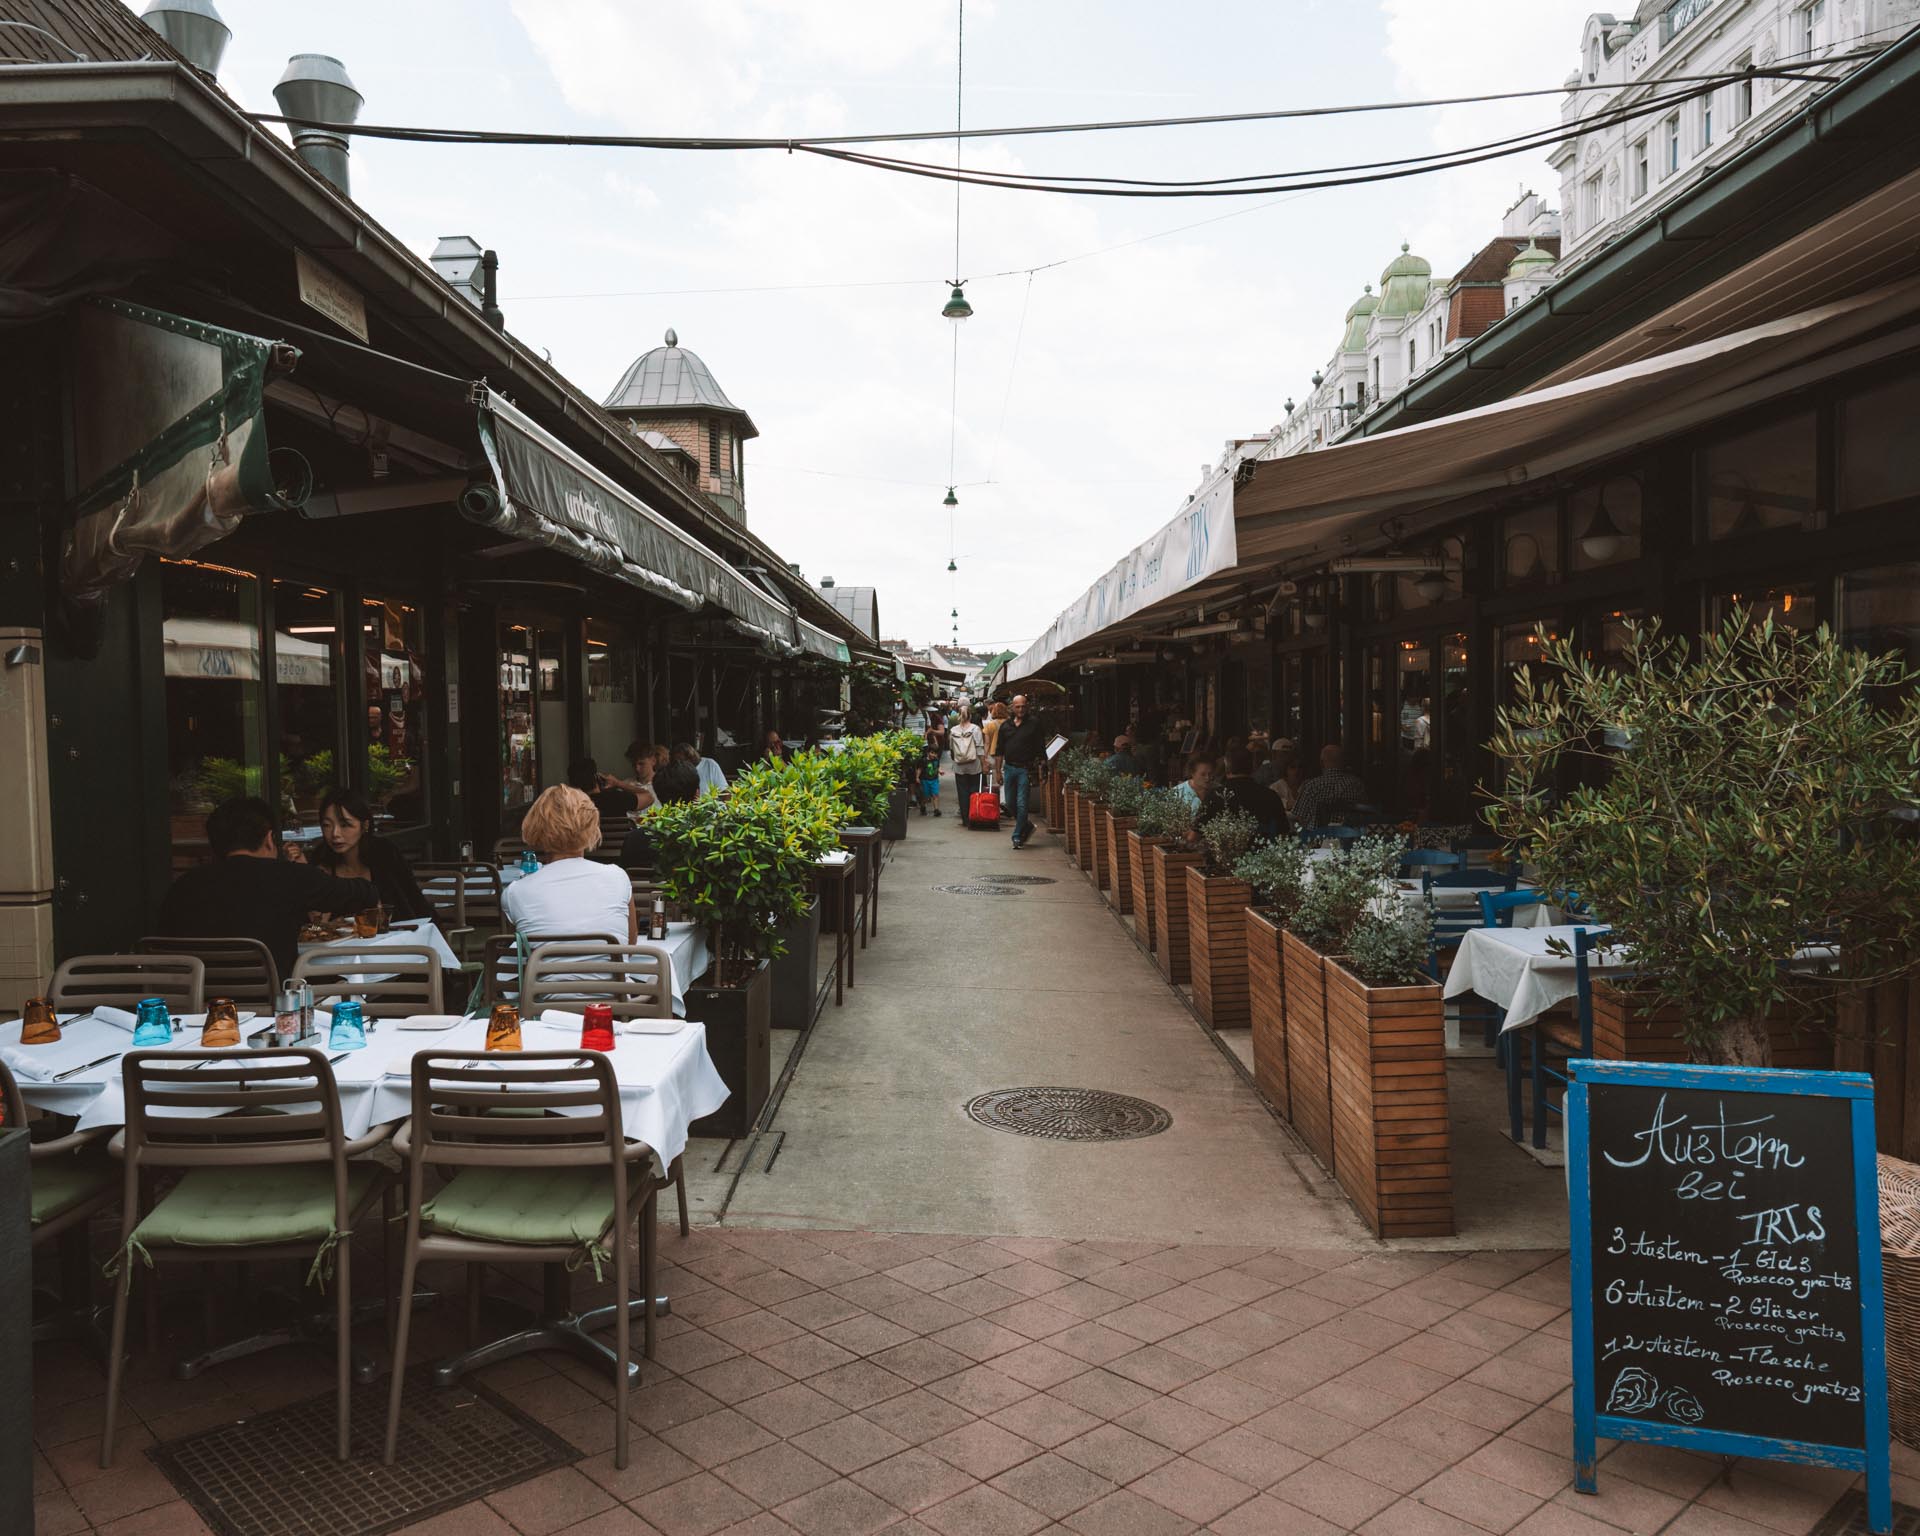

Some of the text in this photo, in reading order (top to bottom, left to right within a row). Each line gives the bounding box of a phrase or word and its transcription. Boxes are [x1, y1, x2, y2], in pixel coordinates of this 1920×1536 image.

[1604, 1092, 1805, 1169] Austern
[1736, 1203, 1826, 1245] IRIS
[1607, 1226, 1626, 1254] 3
[1630, 1230, 1708, 1264] Austern
[1605, 1278, 1625, 1304] 6
[1625, 1280, 1705, 1310] Austern
[1722, 1269, 1852, 1299] Prosecco gratis
[1714, 1316, 1846, 1345] Prosecco gratis
[1601, 1335, 1644, 1361] 12
[1646, 1335, 1725, 1363] Austern
[1711, 1369, 1862, 1404] Prosecco gratis
